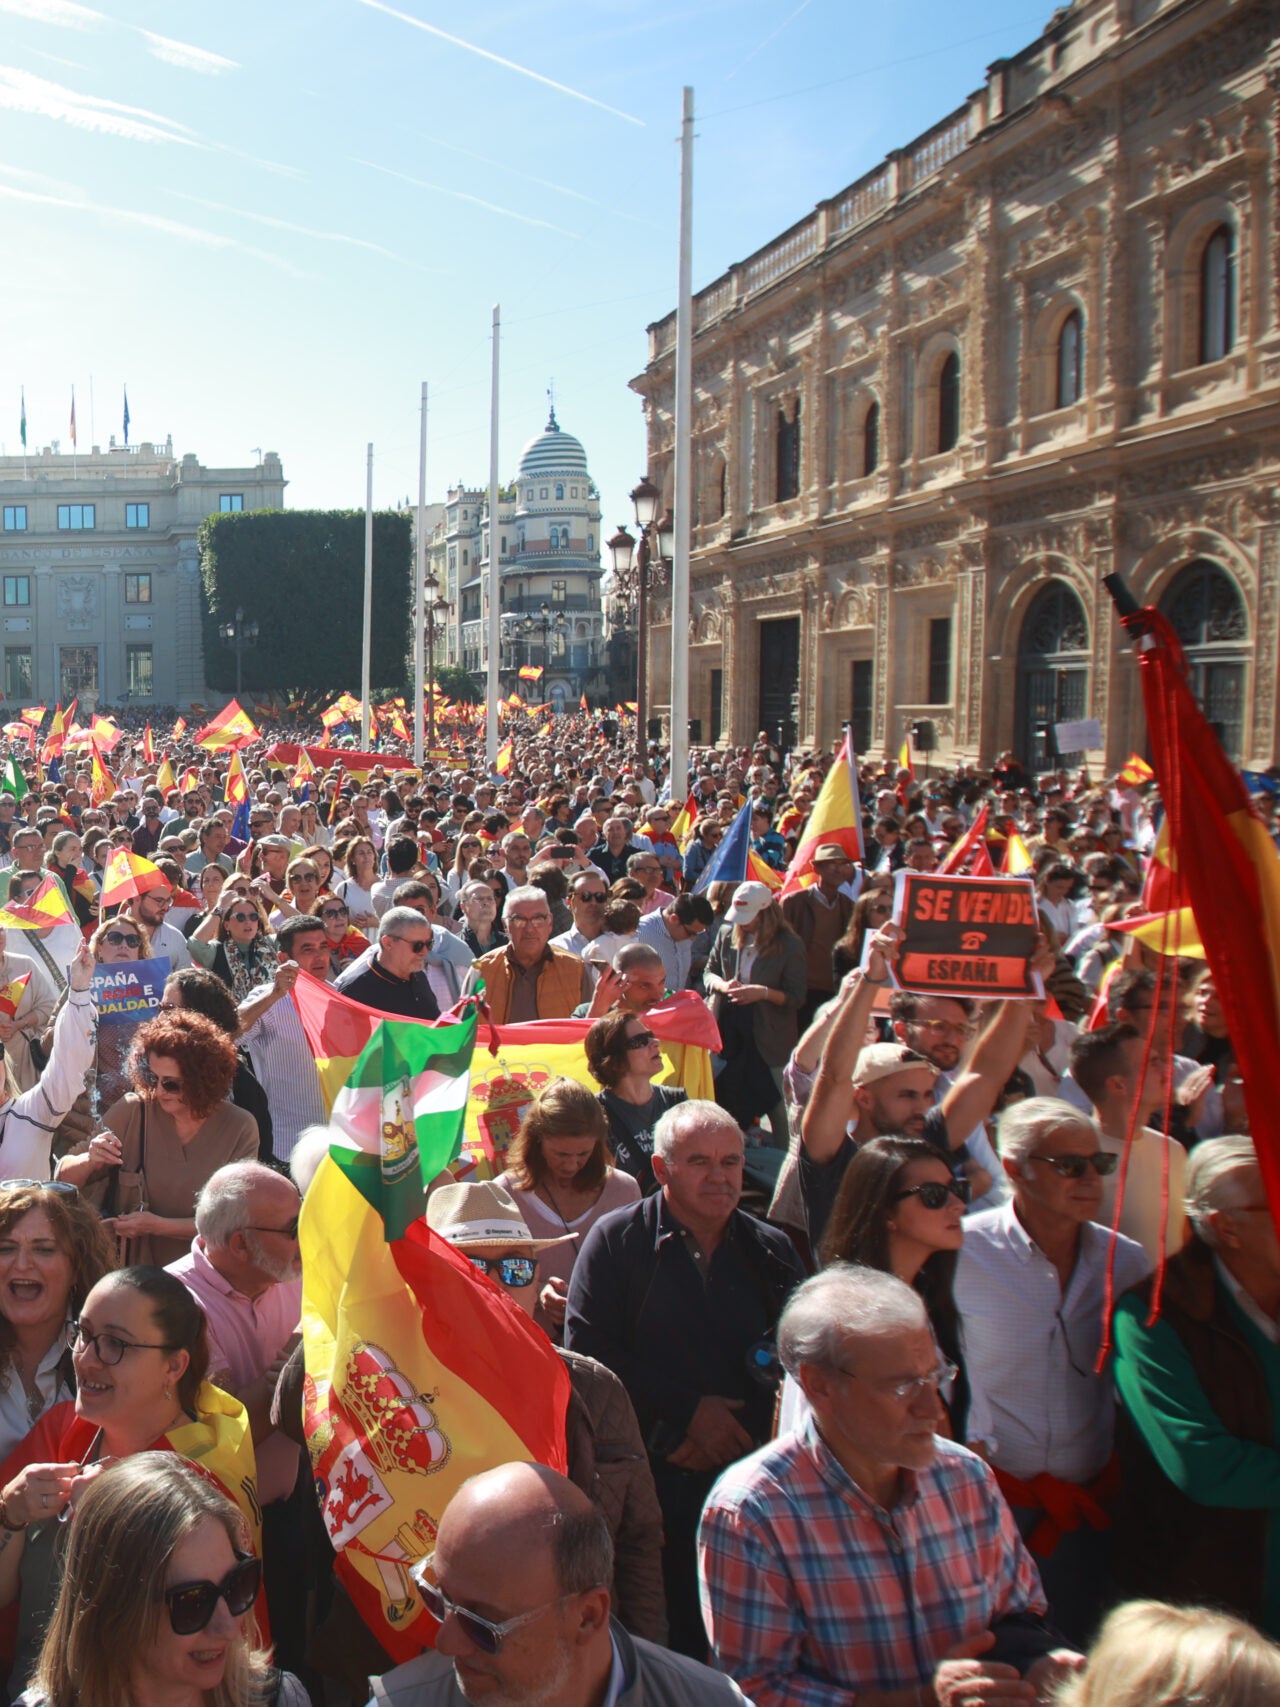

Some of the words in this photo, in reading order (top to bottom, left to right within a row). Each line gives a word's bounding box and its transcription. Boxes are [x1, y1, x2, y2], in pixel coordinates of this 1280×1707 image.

[1, 549, 52, 560] BANCO
[915, 887, 953, 921] SE
[959, 891, 1035, 925] VENDE
[927, 958, 999, 983] ESPAÑA
[88, 971, 139, 989] SPAÑA
[102, 985, 142, 1001] ROJO
[143, 984, 154, 996] E
[96, 997, 160, 1015] UALDAD
